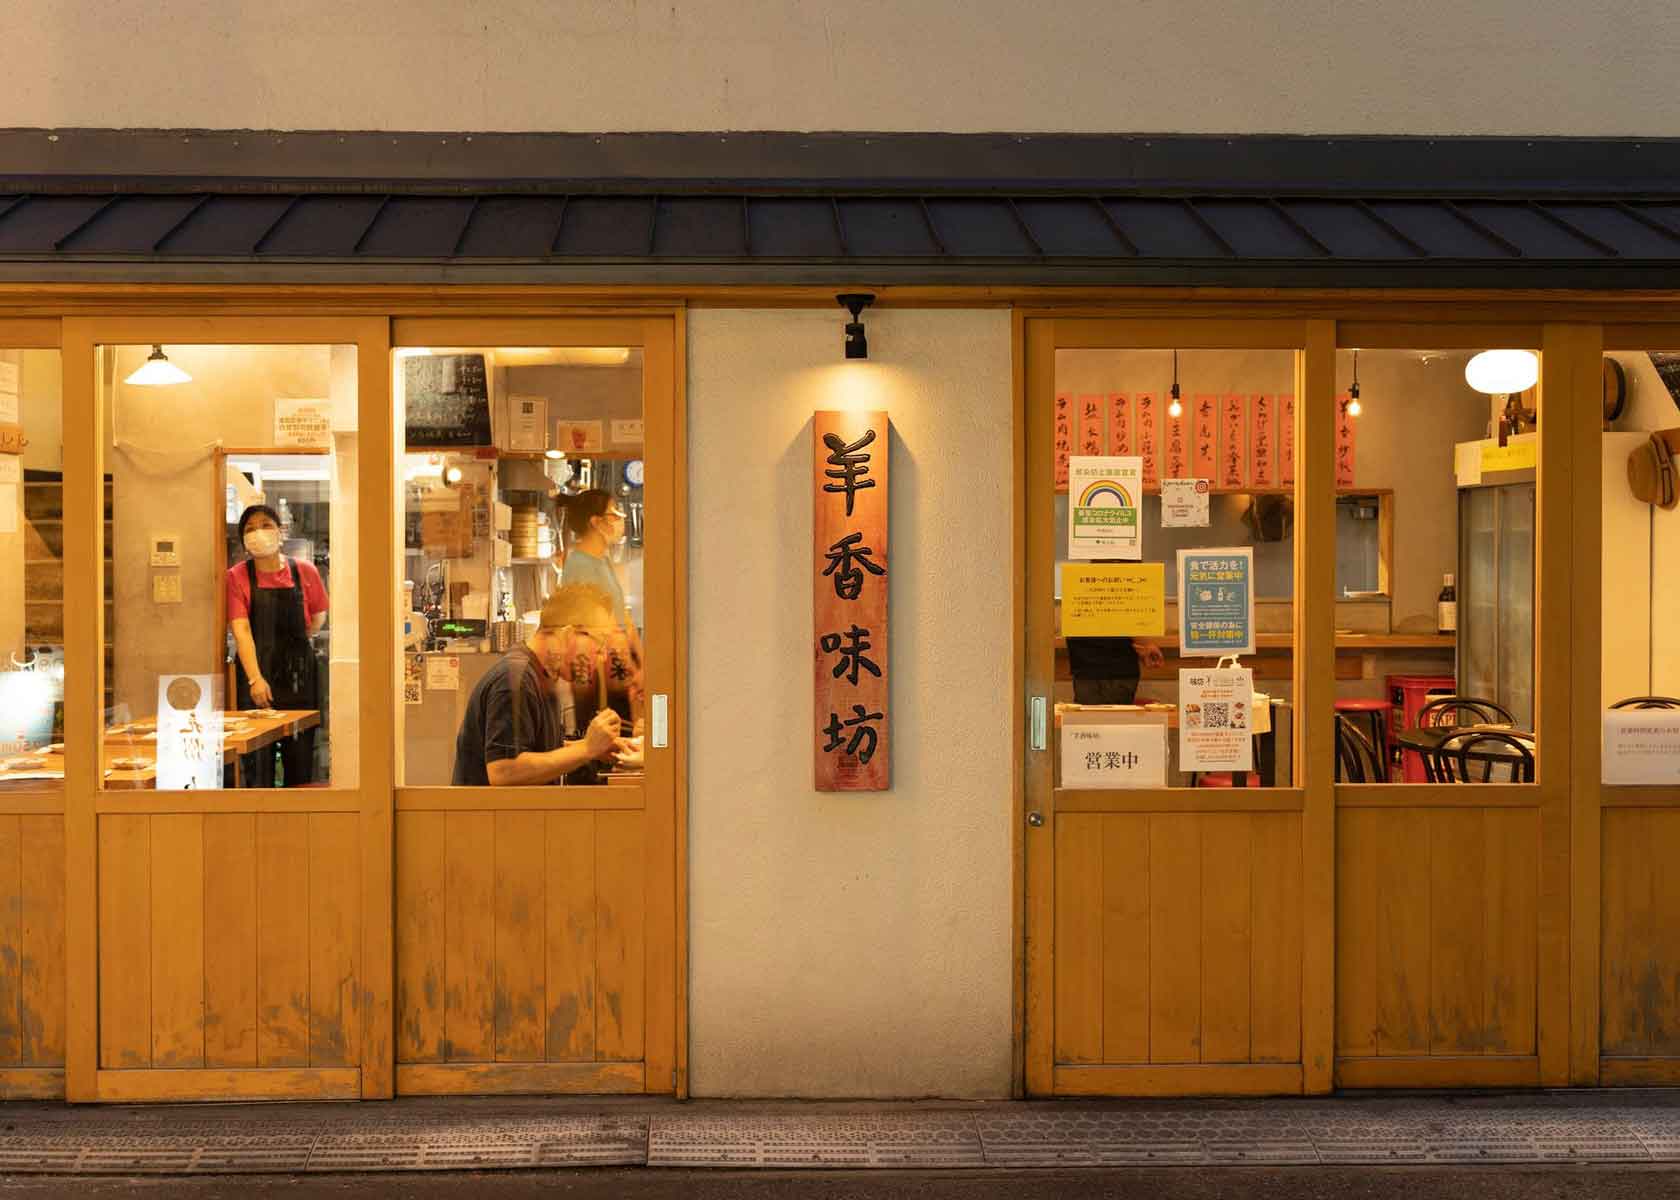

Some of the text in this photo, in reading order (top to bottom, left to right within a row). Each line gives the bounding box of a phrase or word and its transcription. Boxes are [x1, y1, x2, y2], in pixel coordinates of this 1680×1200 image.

[821, 430, 886, 764] 羊香味坊
[1085, 751, 1139, 770] 営業中
